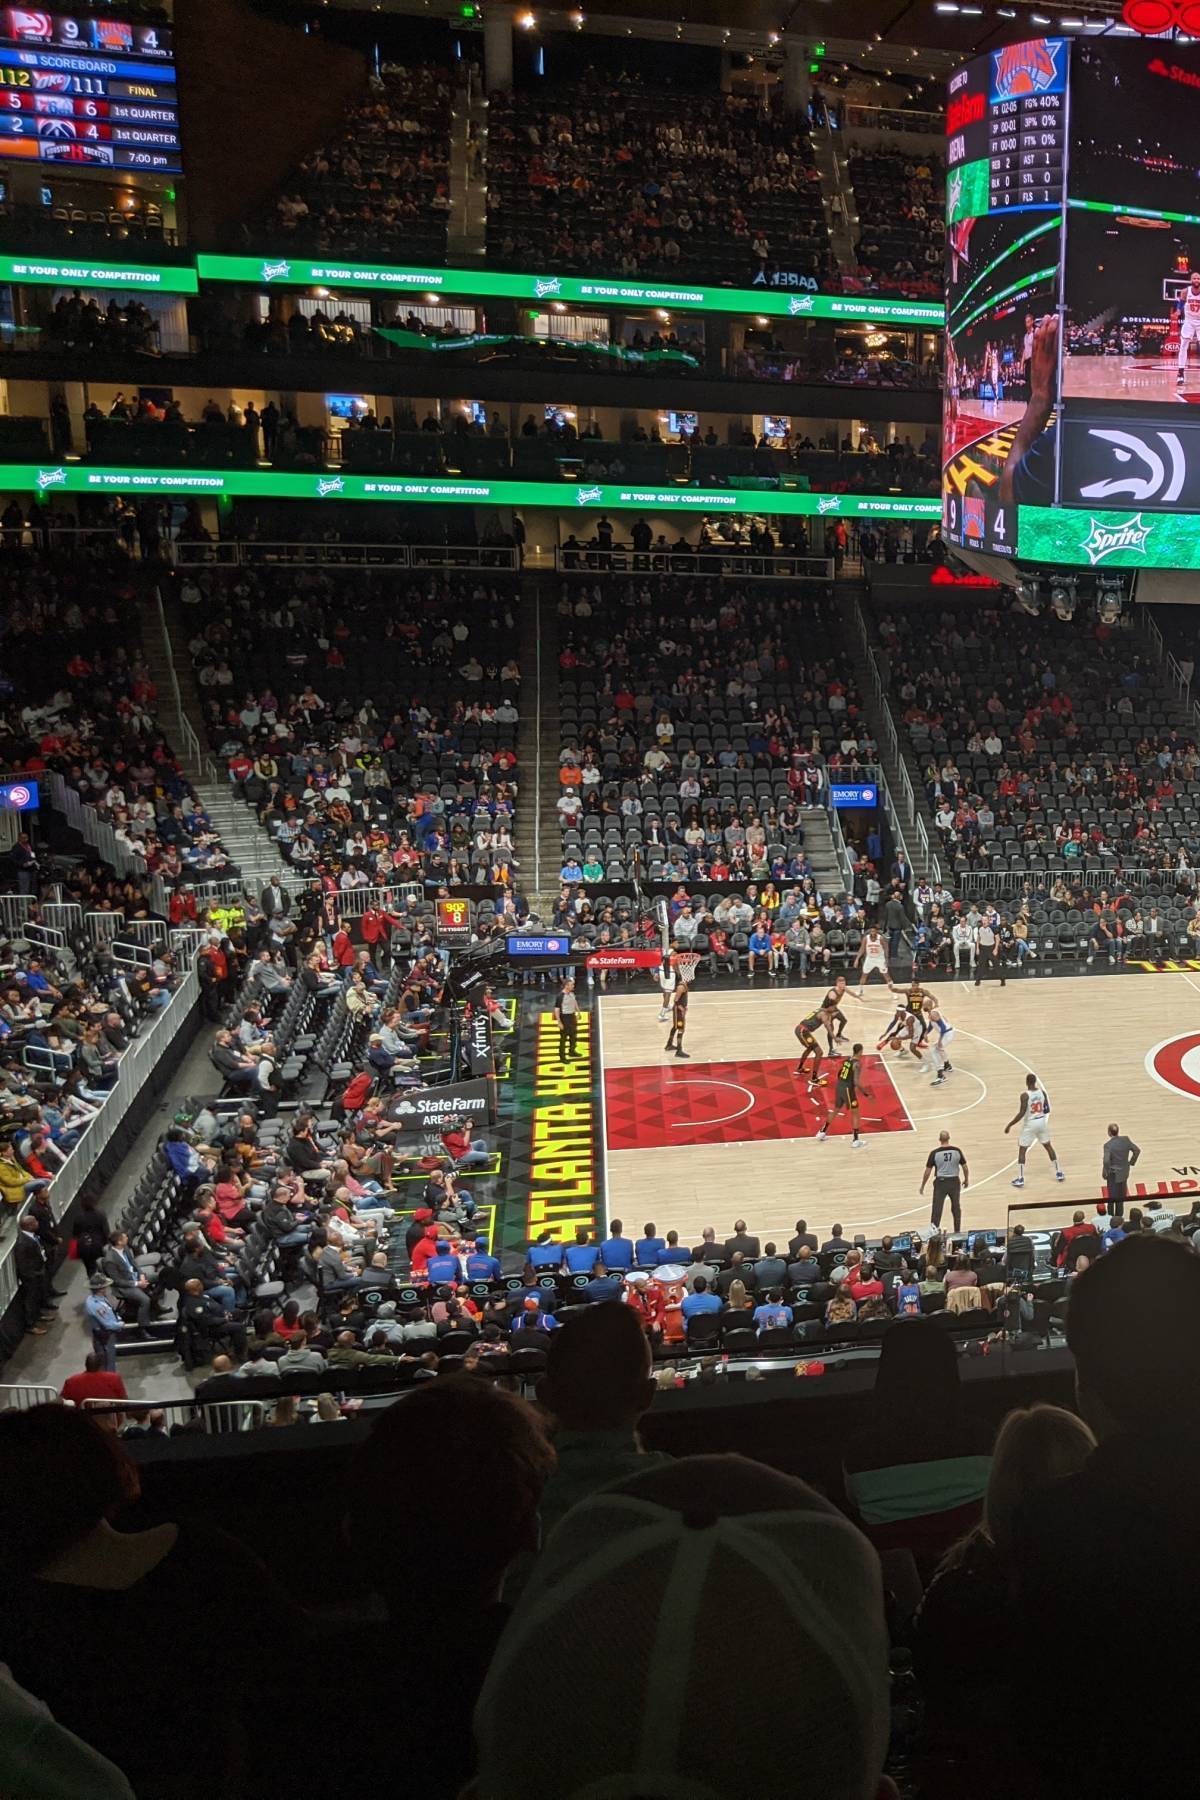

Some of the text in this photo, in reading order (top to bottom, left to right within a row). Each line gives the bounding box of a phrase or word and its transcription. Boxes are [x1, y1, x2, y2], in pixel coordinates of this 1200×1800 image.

[65, 20, 79, 39] 9
[144, 30, 158, 48] 4
[40, 56, 116, 74] SCOREBOARD
[0, 68, 32, 87] 112
[73, 77, 105, 95] 111
[128, 86, 157, 98] FINAL
[10, 93, 21, 108] 5
[86, 101, 97, 116] 6
[115, 107, 128, 117] 1st
[130, 109, 175, 121] QUARTER
[1001, 101, 1017, 114] 02-05
[1025, 98, 1038, 108] FG%
[1040, 96, 1060, 108] 40%
[12, 117, 177, 144] 2 4 1st QUARTER
[1001, 120, 1016, 133] 00-01
[1024, 117, 1038, 128] 3P%
[1042, 115, 1056, 127] 0%
[1001, 138, 1017, 151] 00-00
[1024, 136, 1037, 146] FT%
[1041, 134, 1056, 146] 0%
[128, 153, 168, 165] 7:00 pm
[1006, 158, 1011, 169] 2
[1023, 154, 1035, 165] AST
[1005, 176, 1010, 187] 0
[1023, 173, 1034, 184] STL
[1044, 171, 1051, 183] 0
[1005, 194, 1010, 205] 0
[1022, 191, 1034, 202] FLS
[13, 265, 160, 282] BE YOUR ONLY COMPETITION
[325, 270, 351, 278] YOUR
[354, 271, 378, 280] ONLY
[380, 274, 443, 284] COMPETITION
[88, 475, 224, 486] BE YOUR ONLY COMPETITION
[378, 484, 402, 493] YOUR
[405, 485, 428, 493] ONLY
[430, 486, 490, 495] COMPETITION
[950, 500, 957, 529] 9
[994, 509, 1006, 540] 4
[1090, 526, 1145, 550] Sprite
[832, 790, 859, 799] EMORY
[453, 912, 461, 923] 8
[600, 957, 635, 966] StateFarm
[472, 1012, 489, 1058] xfinity
[417, 1098, 485, 1114] StateFarm
[1030, 1102, 1043, 1114] 30
[943, 1153, 953, 1161] 37
[527, 1102, 596, 1243] ATLANTA
